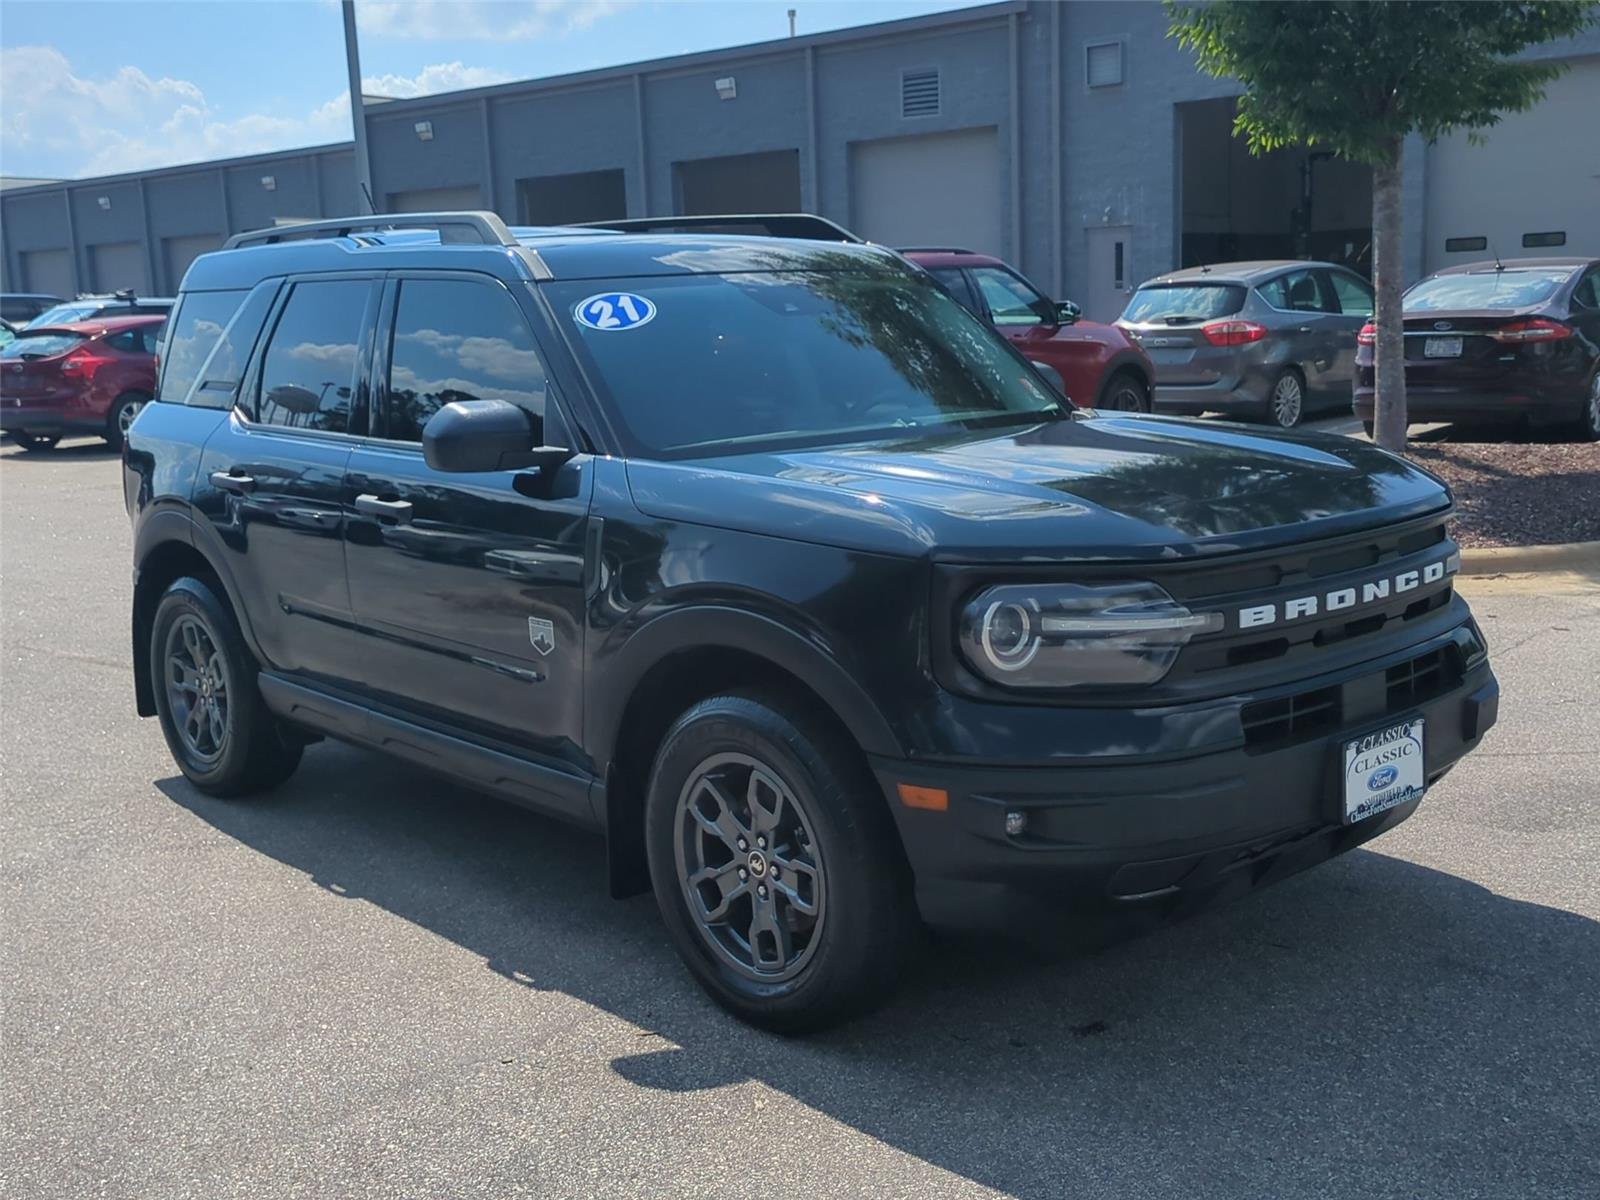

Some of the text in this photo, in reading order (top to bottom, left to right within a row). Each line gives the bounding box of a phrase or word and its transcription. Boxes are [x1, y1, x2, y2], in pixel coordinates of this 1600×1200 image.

[589, 295, 640, 328] 21
[1239, 561, 1444, 629] BRONCO
[1361, 723, 1410, 752] CLASSIC
[1354, 742, 1413, 774] CLASSIC
[1371, 769, 1394, 789] Ford
